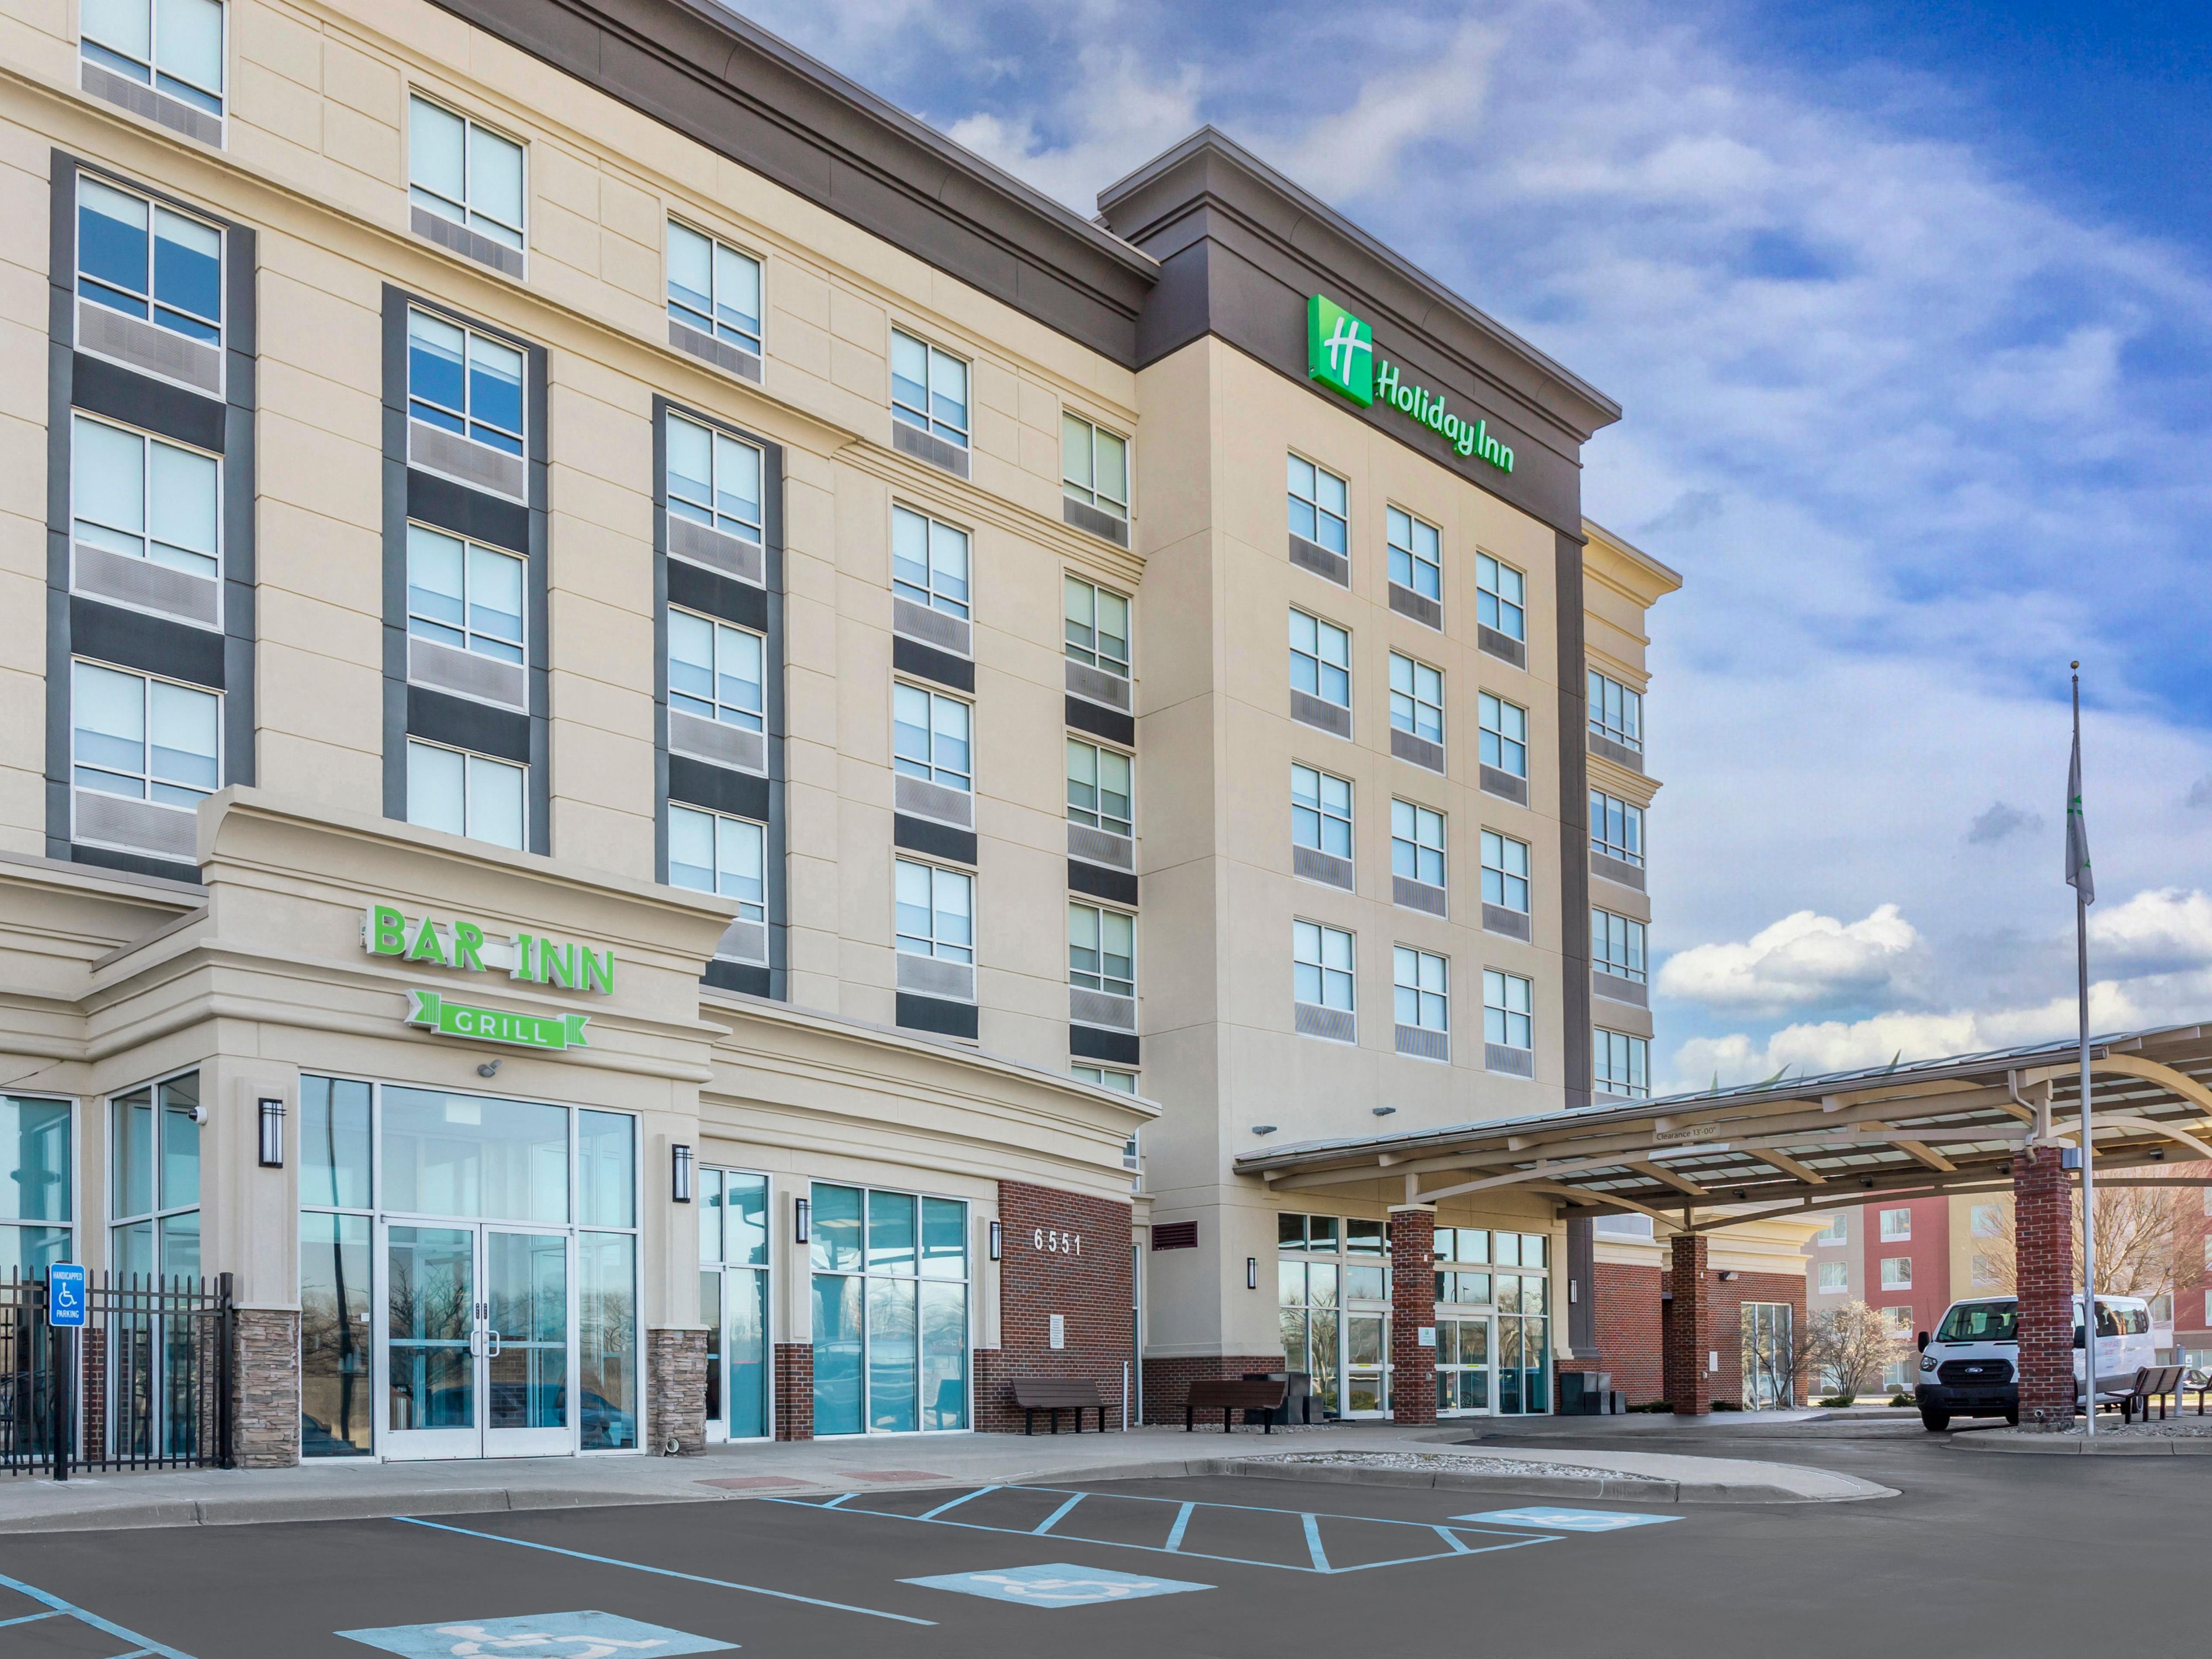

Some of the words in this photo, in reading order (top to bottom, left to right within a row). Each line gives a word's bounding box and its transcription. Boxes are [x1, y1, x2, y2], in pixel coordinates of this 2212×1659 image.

[1376, 359, 1475, 456] Holiday
[1476, 419, 1514, 473] Inn
[369, 904, 487, 972] BAR
[513, 933, 614, 995] INN
[455, 1011, 547, 1043] GRILL
[1656, 1131, 1691, 1140] Clearance
[1034, 1228, 1080, 1255] 6551
[53, 1271, 83, 1281] HANDICAPPED
[56, 1310, 79, 1318] PARKING
